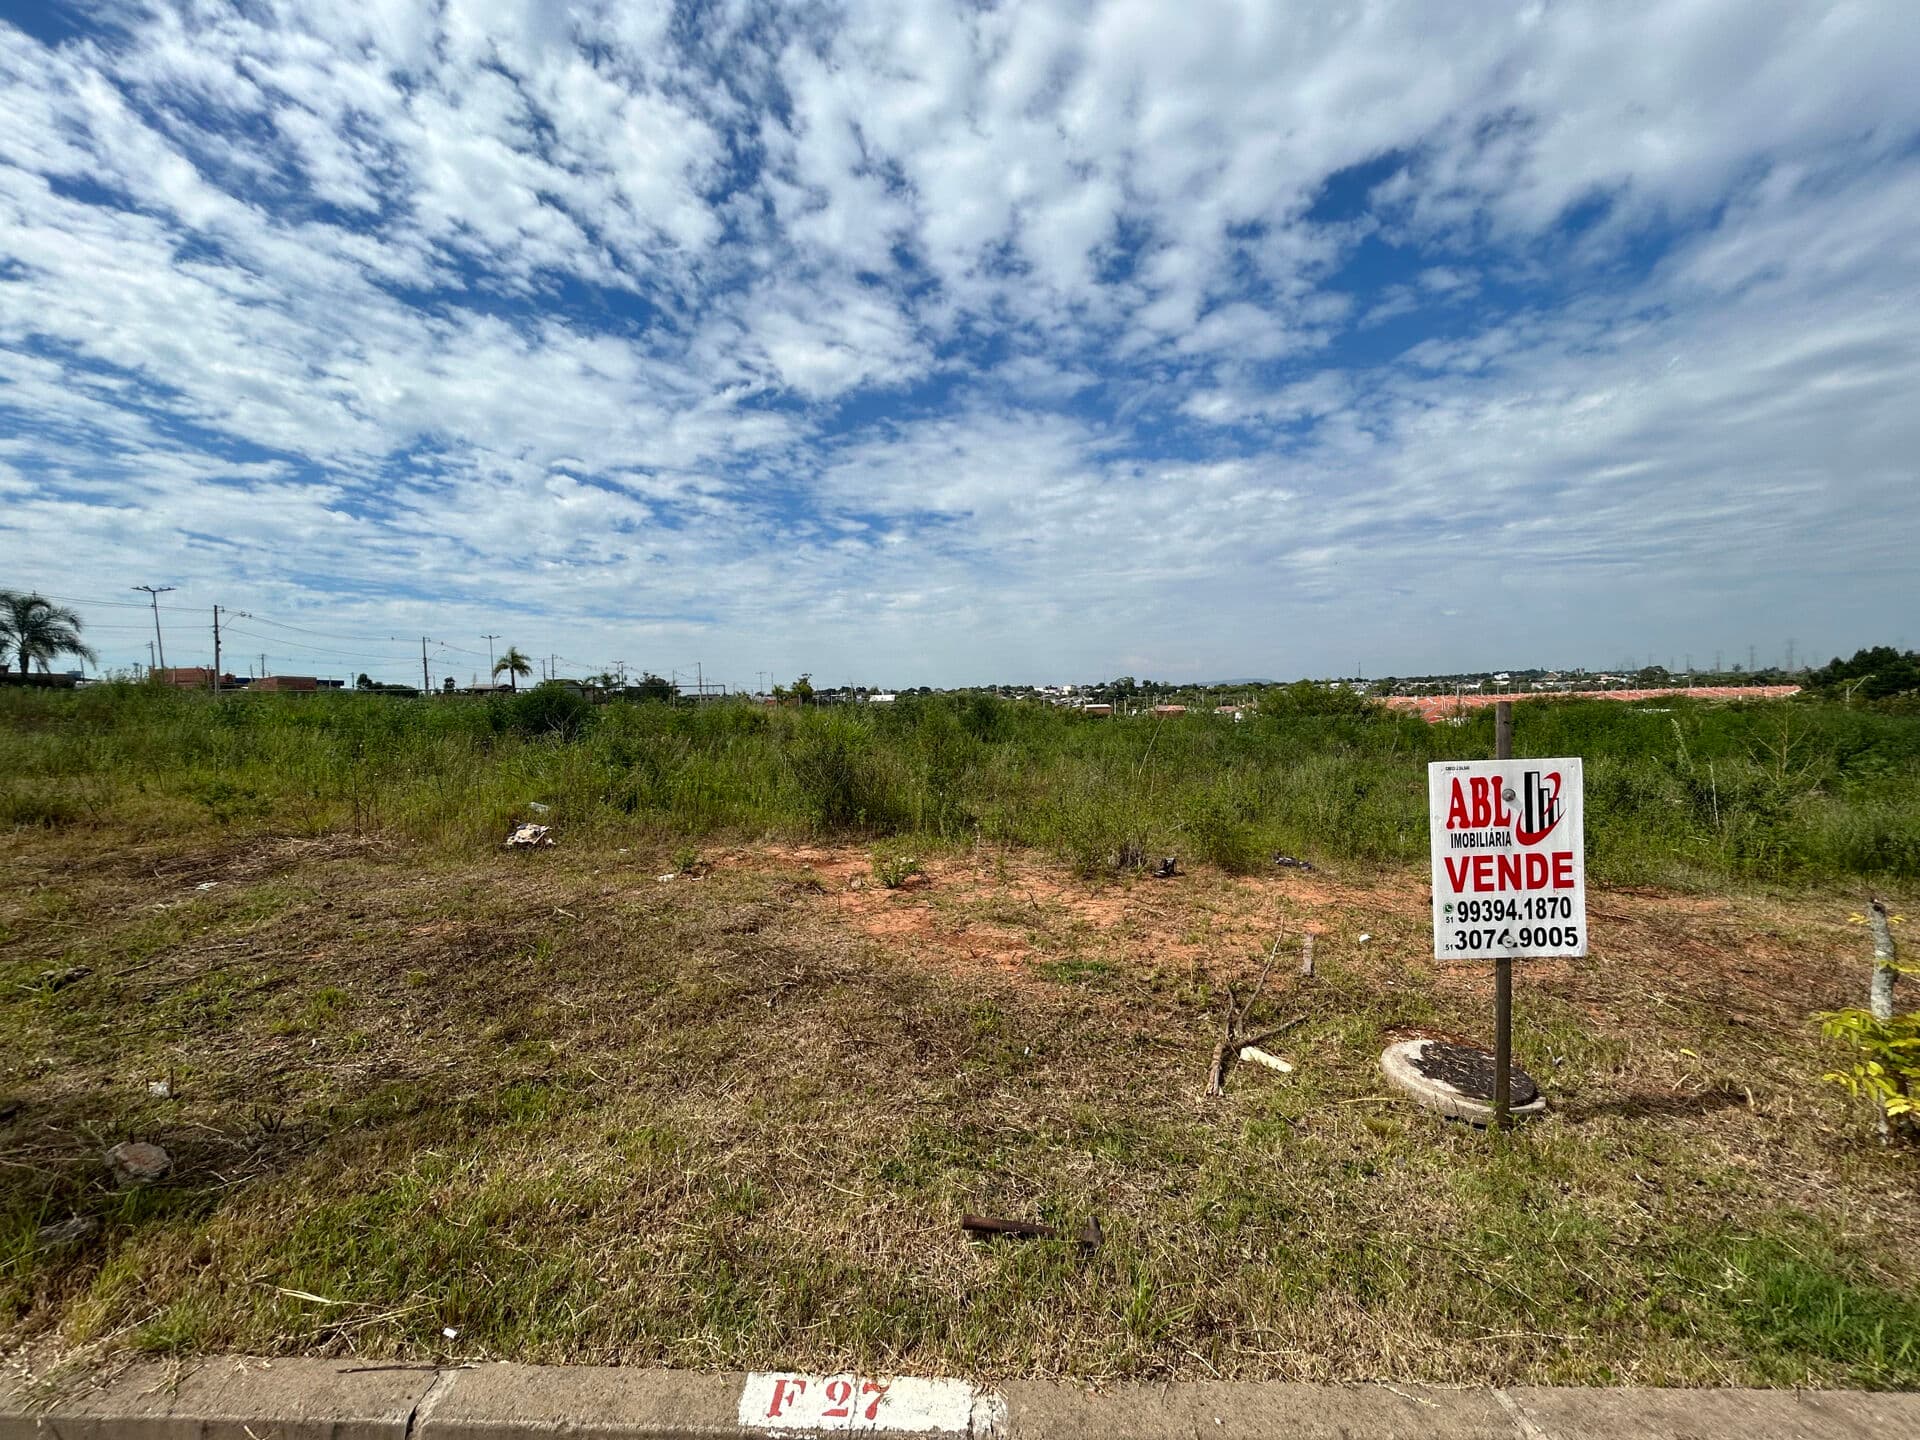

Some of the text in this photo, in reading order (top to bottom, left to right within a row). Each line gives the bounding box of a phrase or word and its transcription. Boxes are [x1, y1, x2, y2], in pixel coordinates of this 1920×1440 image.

[1446, 775, 1511, 829] ABL
[1450, 828, 1512, 849] IMOBILIÁRIA
[1444, 851, 1575, 893] VENDE
[1445, 896, 1572, 924] 51 99394.1870
[766, 1379, 890, 1420] F 27
